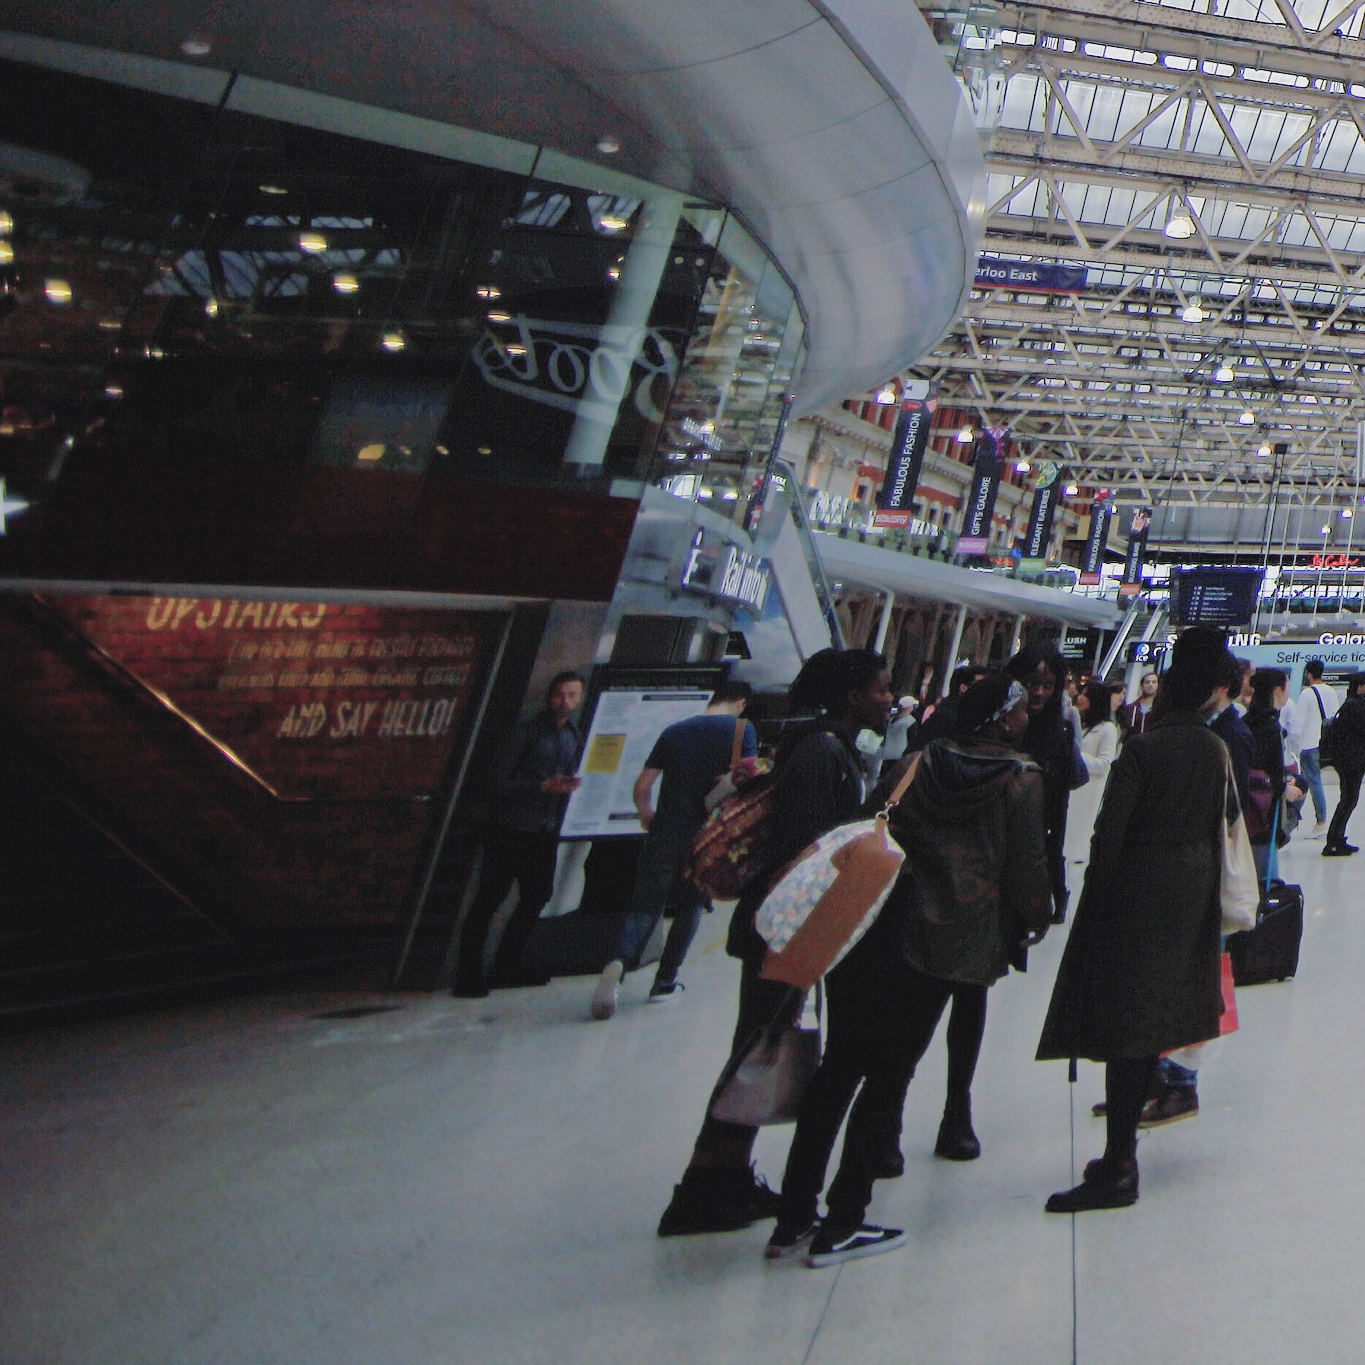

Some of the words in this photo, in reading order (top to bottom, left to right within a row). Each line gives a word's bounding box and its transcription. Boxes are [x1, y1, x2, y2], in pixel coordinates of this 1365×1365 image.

[1009, 268, 1039, 282] East
[890, 456, 912, 507] FABULOUS
[903, 412, 921, 455] FASHION
[977, 476, 992, 511] GALORE
[971, 511, 984, 535] GIFTS
[1030, 522, 1043, 556] ELEGANT
[1038, 489, 1051, 522] EATERIES
[1135, 654, 1149, 662] ice
[1276, 651, 1348, 665] Self-service
[279, 702, 328, 737] AND
[330, 700, 378, 737] SAY
[378, 696, 459, 737] HELLO!
